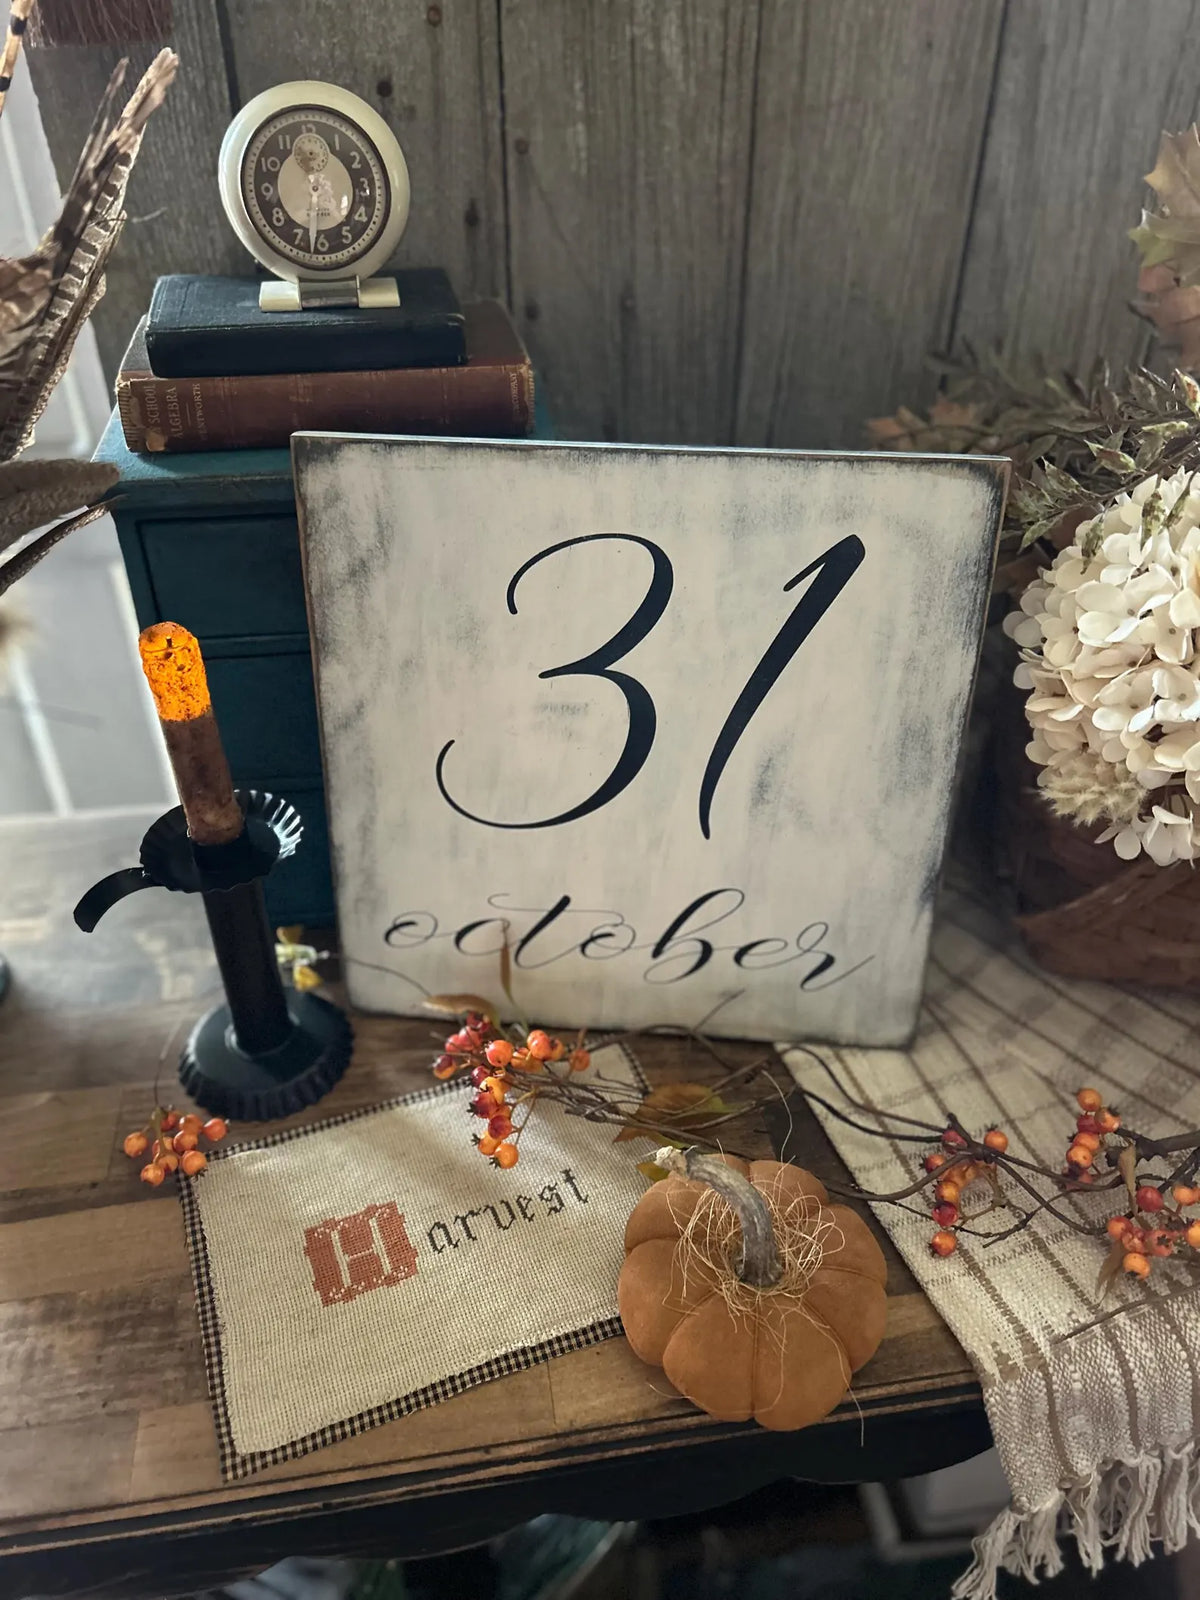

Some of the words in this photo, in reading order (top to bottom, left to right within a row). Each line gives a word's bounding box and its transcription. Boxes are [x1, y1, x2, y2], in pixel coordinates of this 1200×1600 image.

[279, 134, 291, 150] 11
[334, 134, 340, 151] 1
[261, 156, 280, 172] 10
[350, 152, 362, 168] 2
[260, 183, 273, 200] 9
[360, 179, 370, 197] 3
[272, 207, 285, 227] 8
[354, 207, 367, 222] 4
[293, 229, 304, 245] 7
[317, 235, 329, 251] 6
[342, 226, 352, 244] 5
[143, 384, 161, 424] SCHOOL
[166, 386, 183, 439] ALGEBRA
[436, 532, 866, 841] 31
